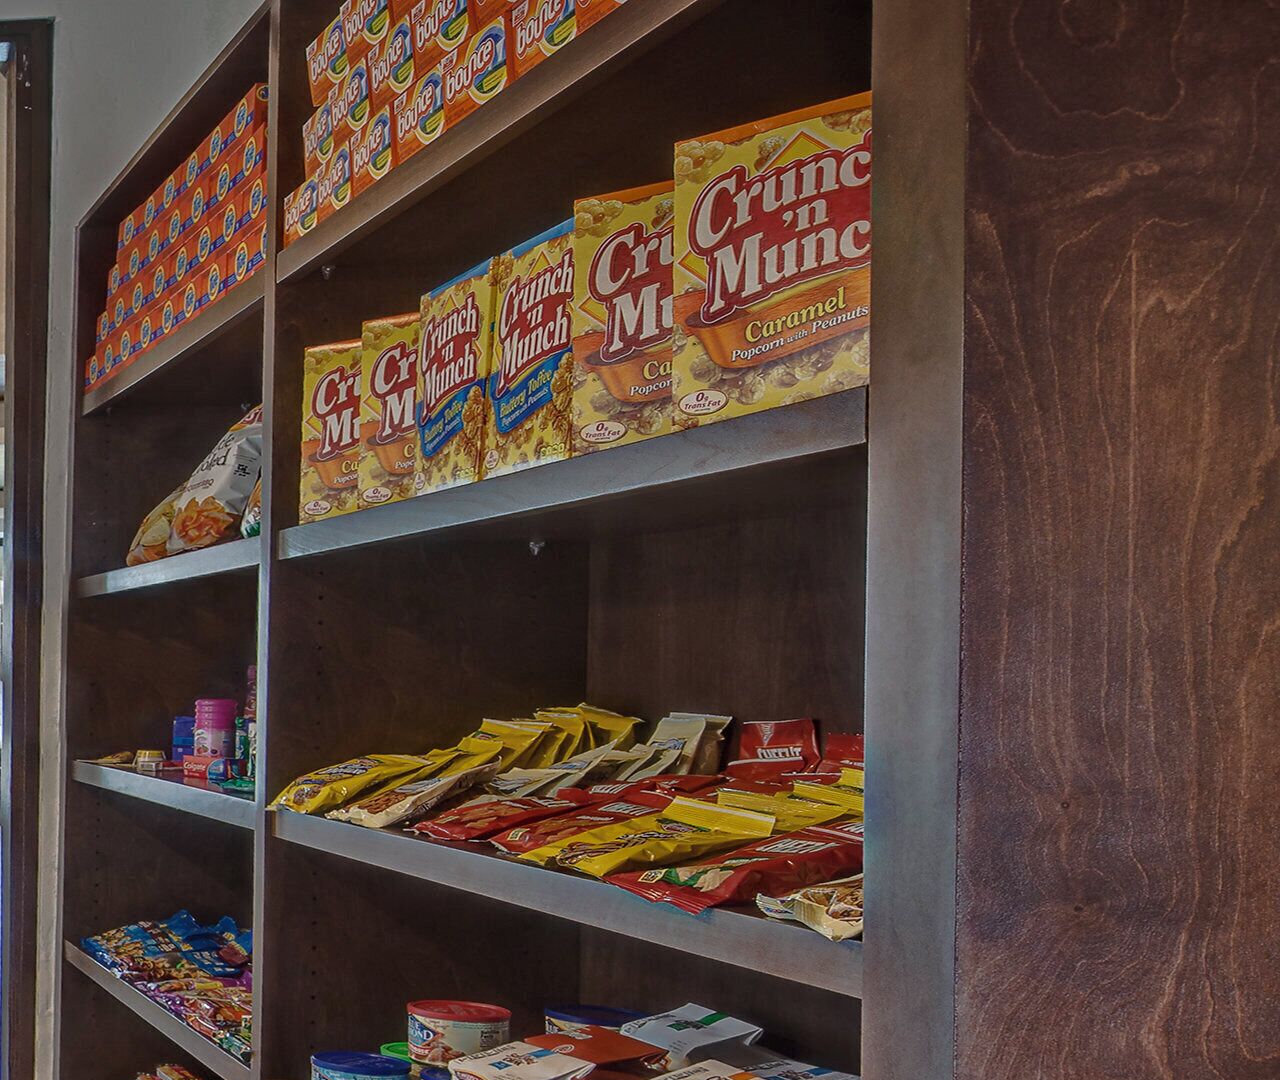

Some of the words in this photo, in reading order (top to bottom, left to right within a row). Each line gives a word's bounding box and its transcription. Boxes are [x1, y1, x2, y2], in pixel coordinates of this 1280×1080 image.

[311, 30, 341, 82] bounce
[371, 34, 404, 90] bounce
[445, 39, 495, 102] bounce
[332, 78, 360, 126] bounce
[397, 86, 434, 140] bounce
[353, 123, 382, 173] bounce
[285, 190, 313, 232] bounce
[695, 151, 872, 249] Crunc
[501, 253, 574, 338] Crunch
[710, 220, 871, 314] Munc
[422, 295, 478, 370] Crunch
[731, 336, 785, 361] Popcorn
[787, 329, 808, 344] with
[812, 305, 870, 334] Peanuts
[744, 286, 847, 344] Caramel
[499, 310, 570, 392] Munch
[424, 352, 475, 416] Munch
[707, 398, 722, 409] Fat
